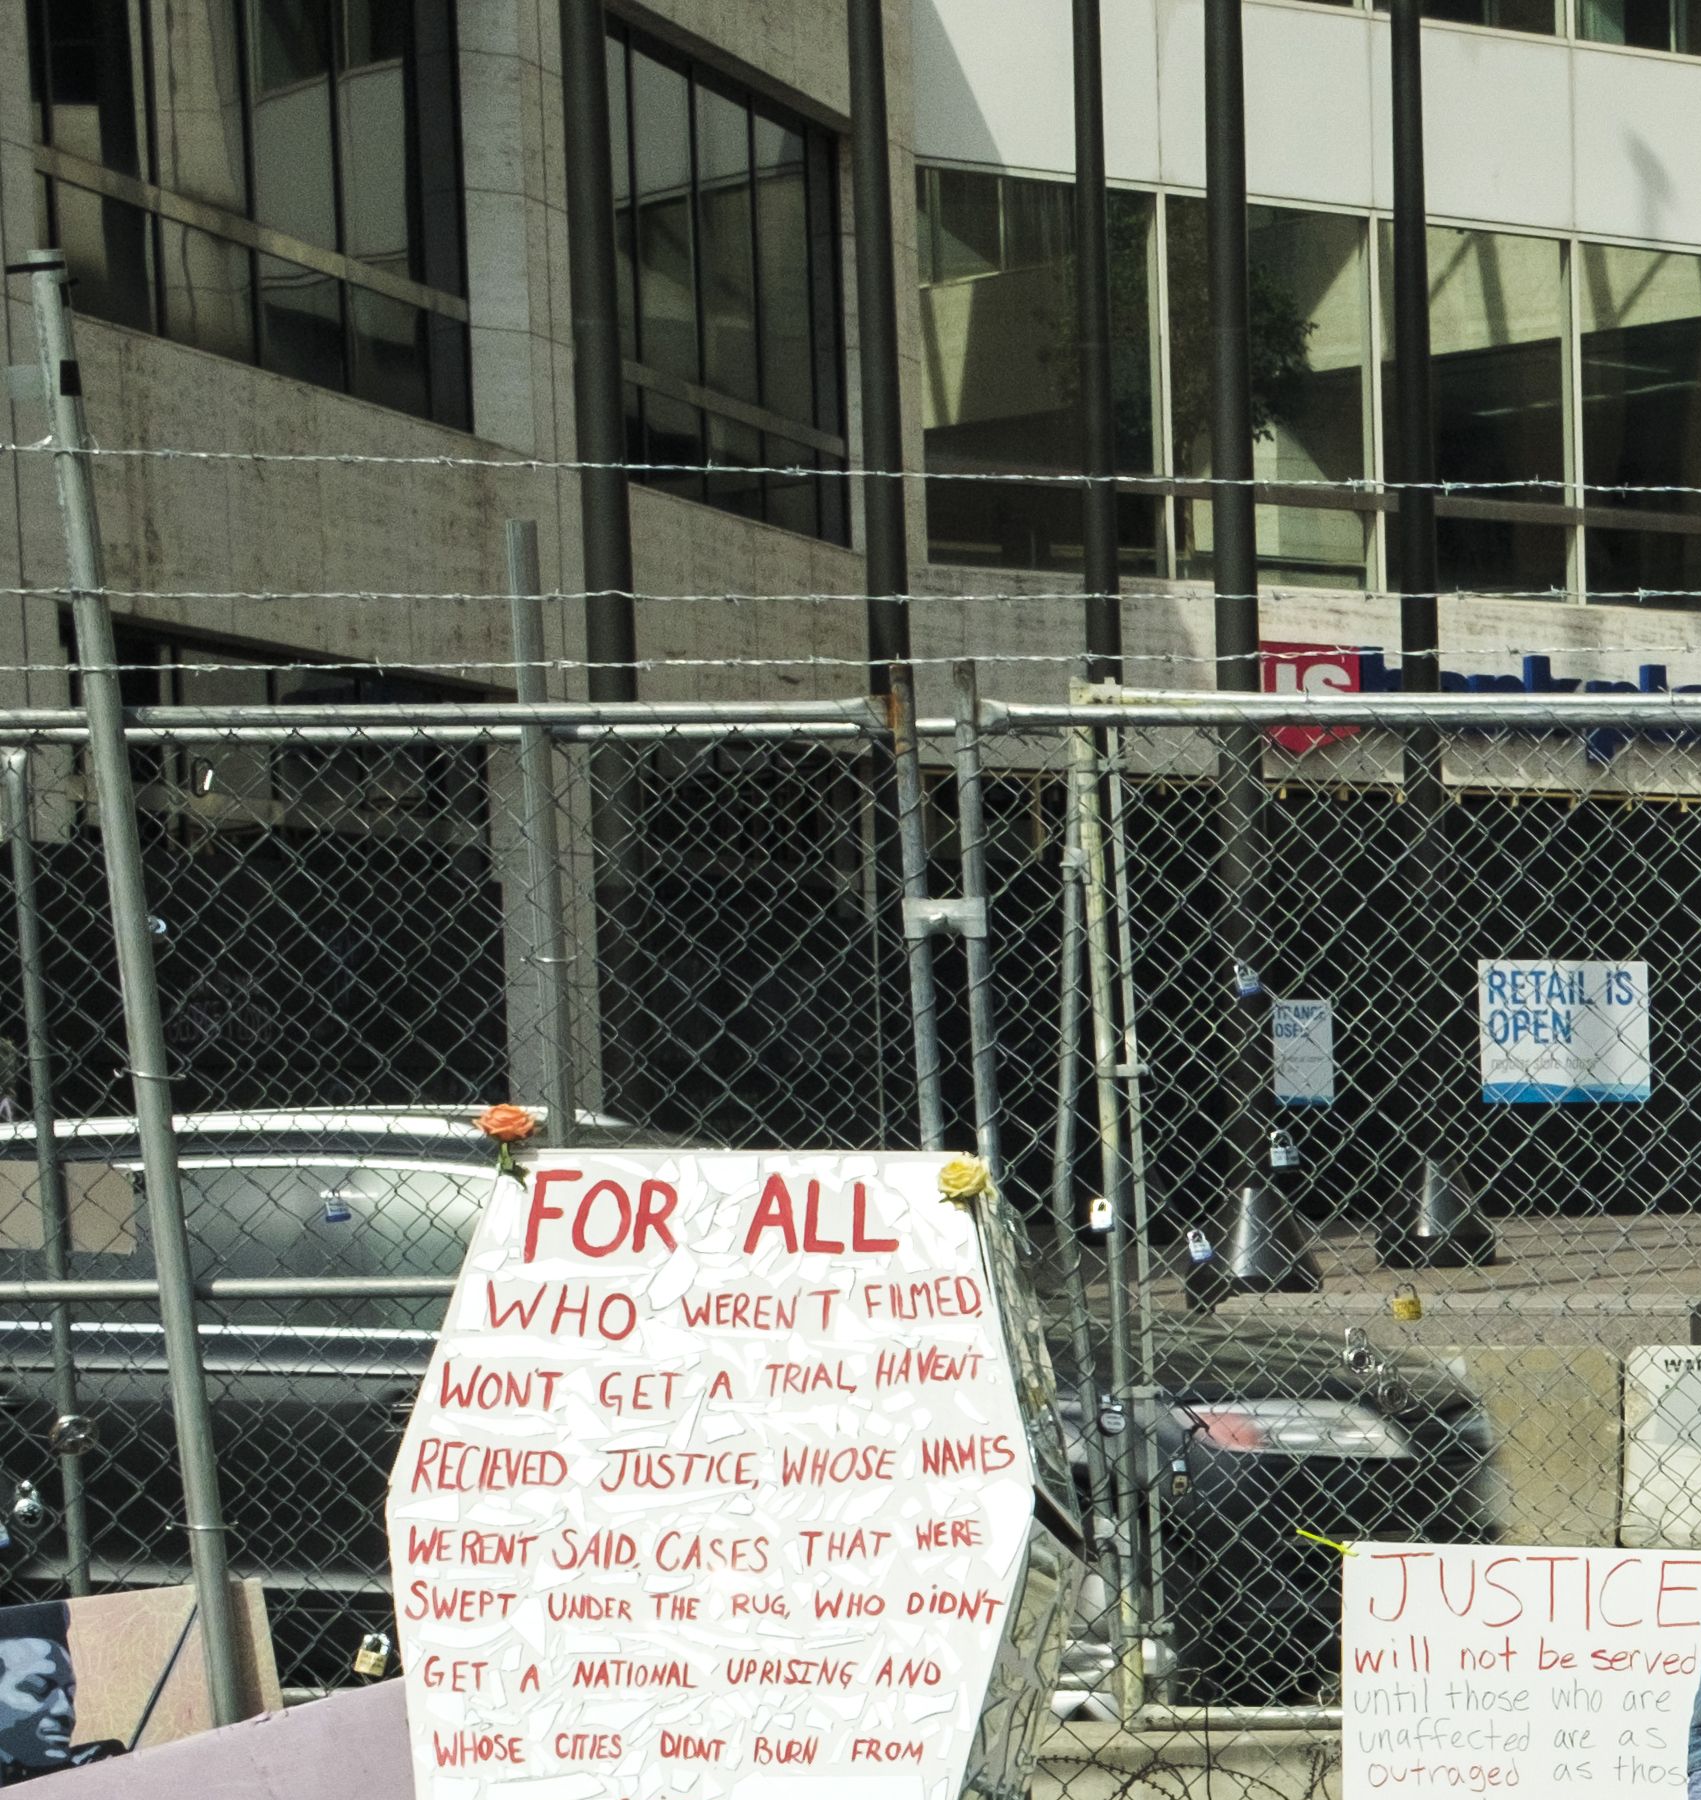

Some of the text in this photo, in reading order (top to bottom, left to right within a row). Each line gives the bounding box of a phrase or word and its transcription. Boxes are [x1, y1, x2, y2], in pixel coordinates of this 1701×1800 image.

[1488, 970, 1633, 1005] RETAIL IS
[1488, 1009, 1572, 1044] OPEN
[524, 1169, 901, 1263] FOR ALL
[486, 1280, 637, 1341] WHO
[681, 1286, 841, 1331] WEREN'T
[439, 1362, 562, 1411] WON'T
[600, 1372, 683, 1411] GET
[709, 1371, 733, 1400] A
[875, 1345, 985, 1387] HAVEN'T
[411, 1435, 1017, 1493] RECIEVED JUSTICE, WHOSE NAMES
[407, 1527, 538, 1566] WEREN'T
[656, 1530, 770, 1572] CASES
[801, 1530, 891, 1561] THAT
[916, 1518, 986, 1548] WERE
[404, 1580, 516, 1621] SWEPT
[547, 1595, 634, 1621] UNDER
[650, 1593, 700, 1621] THE
[732, 1593, 791, 1620] RUG,
[813, 1593, 886, 1618] WHO
[424, 1655, 942, 1692] GET A NATIONAL UPRISING AND
[1354, 1634, 1698, 1675] will not be served
[1353, 1678, 1672, 1714] until those who are
[433, 1732, 526, 1768] WHOSE
[555, 1733, 623, 1762] CITIES
[753, 1733, 819, 1766] BURN
[852, 1738, 924, 1766] FROM
[1358, 1716, 1667, 1754] unaffected are as
[1367, 1761, 1521, 1792] outraged
[1552, 1759, 1594, 1782] as
